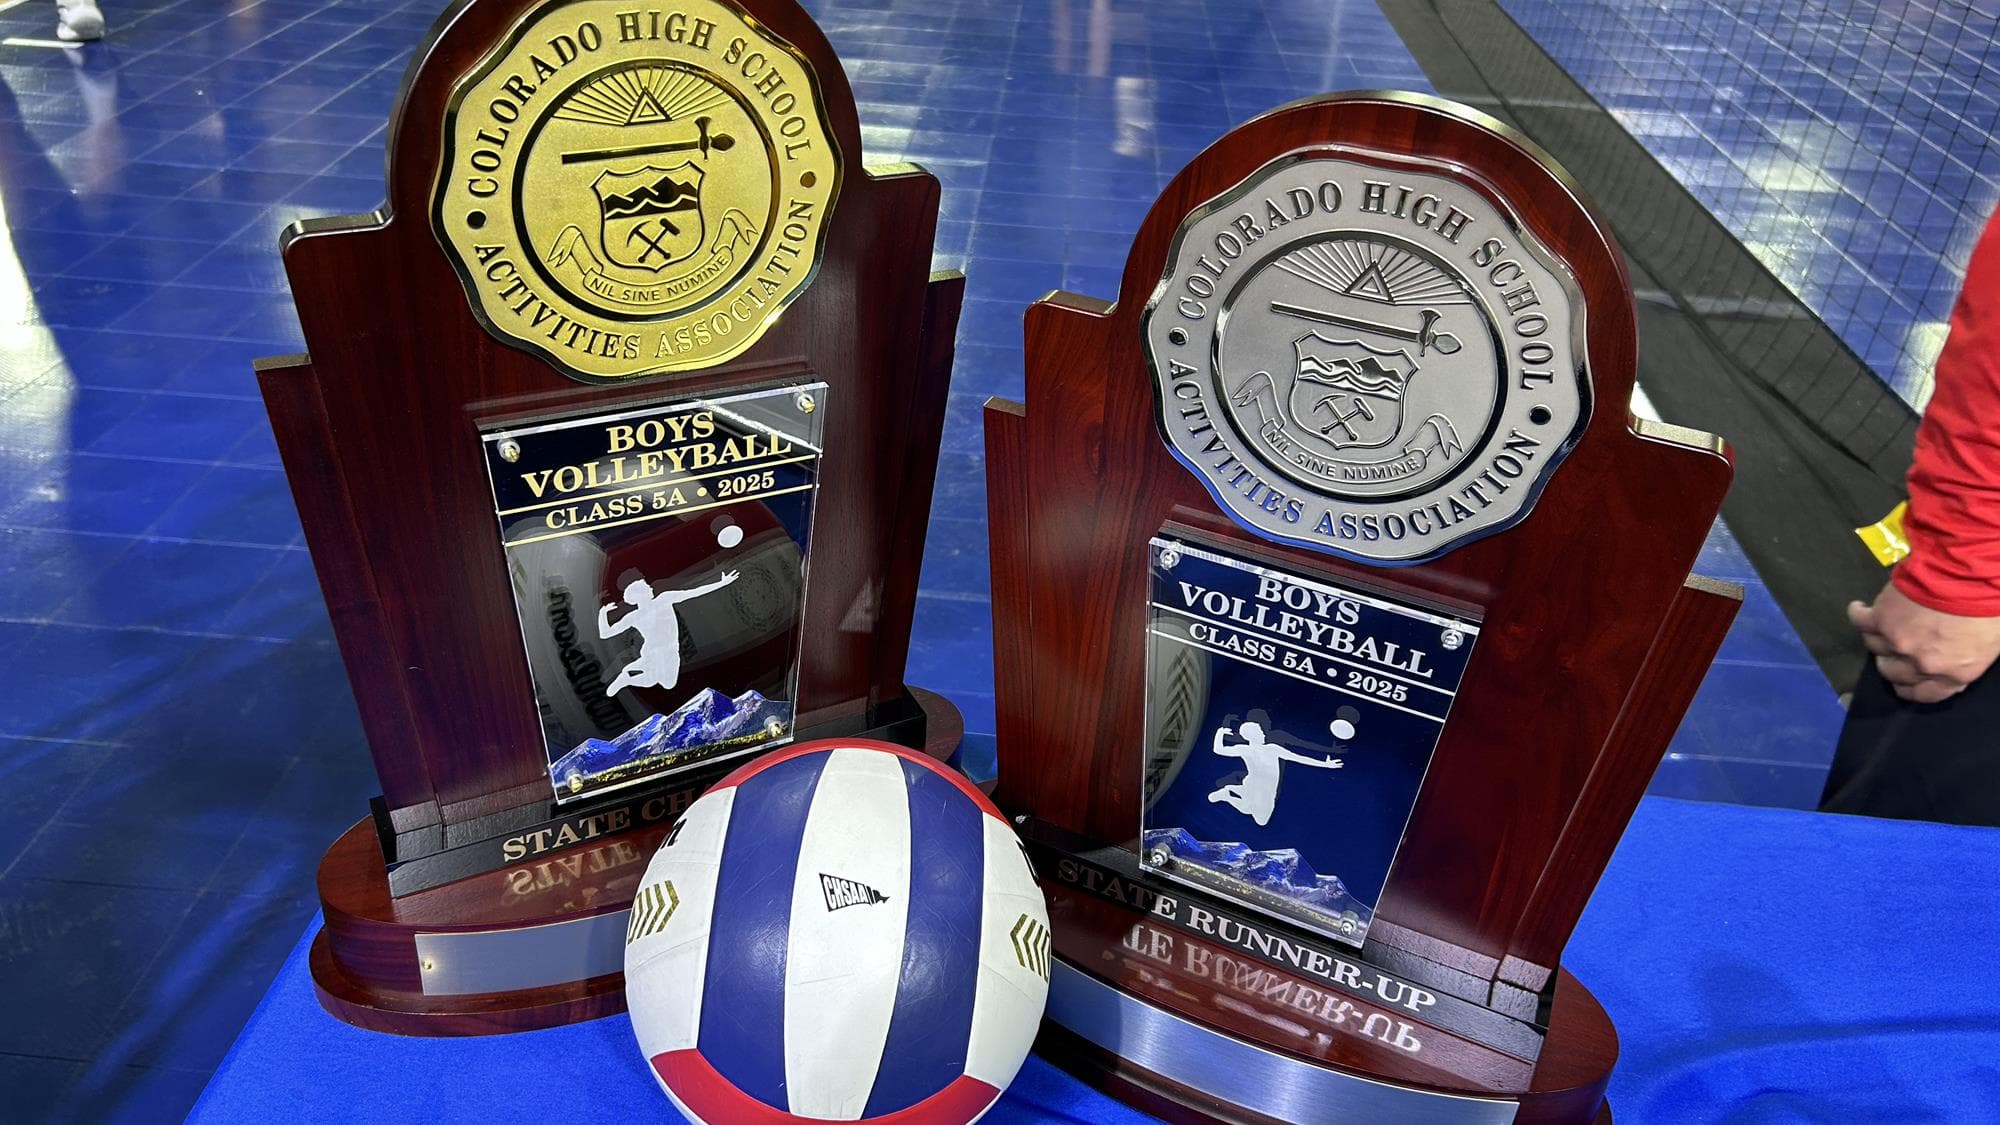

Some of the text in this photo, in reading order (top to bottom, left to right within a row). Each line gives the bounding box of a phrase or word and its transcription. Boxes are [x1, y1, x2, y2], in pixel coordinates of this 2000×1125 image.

[468, 11, 811, 199] COLORADO HIGH SCHOOL
[475, 198, 815, 360] ACTIVITIES ASSOCIATION
[589, 256, 728, 301] NIL SINE NUMINE
[1178, 180, 1555, 391] COLORADO HIGH SCHOOL
[521, 432, 792, 498] VOLLEYBALL
[606, 411, 715, 453] BOYS
[1170, 359, 1542, 541] ACTIVITIES ASSOCIATION
[1266, 429, 1420, 479] NIL SINE NUMINE
[546, 471, 776, 529] CLASS 5A 2025
[1178, 581, 1433, 678] VOLLEYBALL
[1255, 576, 1361, 625] BOYS
[1189, 623, 1408, 702] CLASS 5A 2025
[503, 806, 631, 862] STATE
[822, 875, 869, 910] CHSAA
[1057, 859, 1176, 921] STATE
[1188, 905, 1436, 1012] RUNNER-UP
